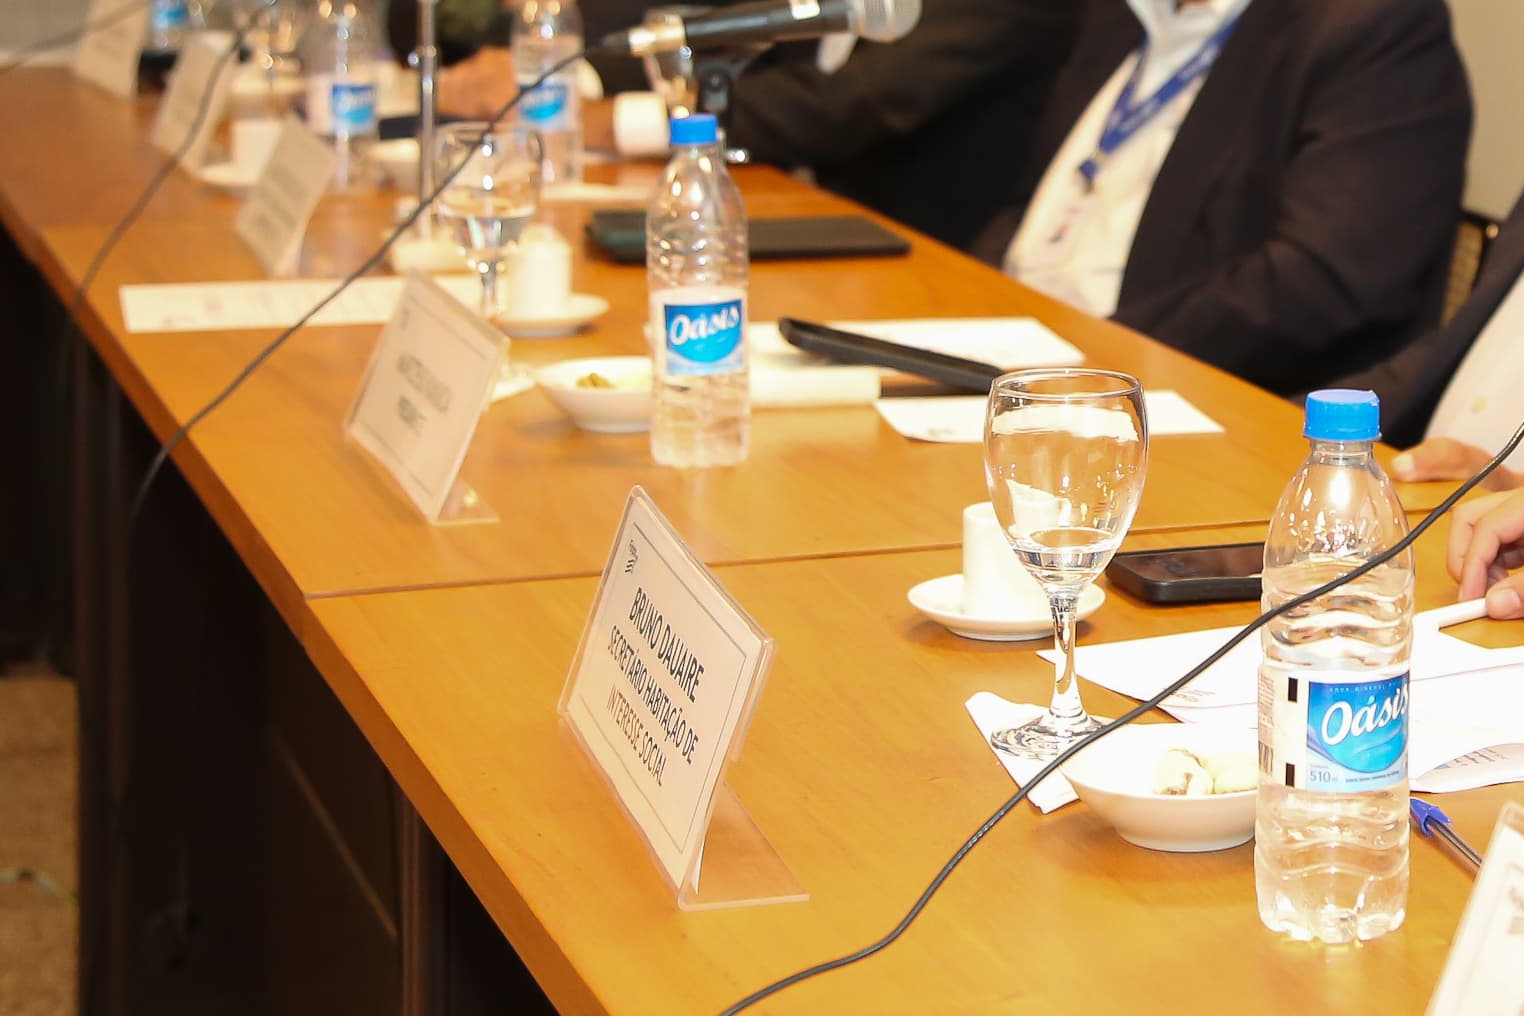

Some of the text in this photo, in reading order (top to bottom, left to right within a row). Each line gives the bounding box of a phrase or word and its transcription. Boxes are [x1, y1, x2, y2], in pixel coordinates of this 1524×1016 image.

[607, 625, 699, 765] SECRETÁRIO HABITAÇÃO DE
[629, 586, 705, 704] BRUNO DAUAIRE
[606, 683, 667, 787] INTERESSE SOCIAL
[1321, 683, 1408, 746] Oásis
[1309, 770, 1332, 783] 510
